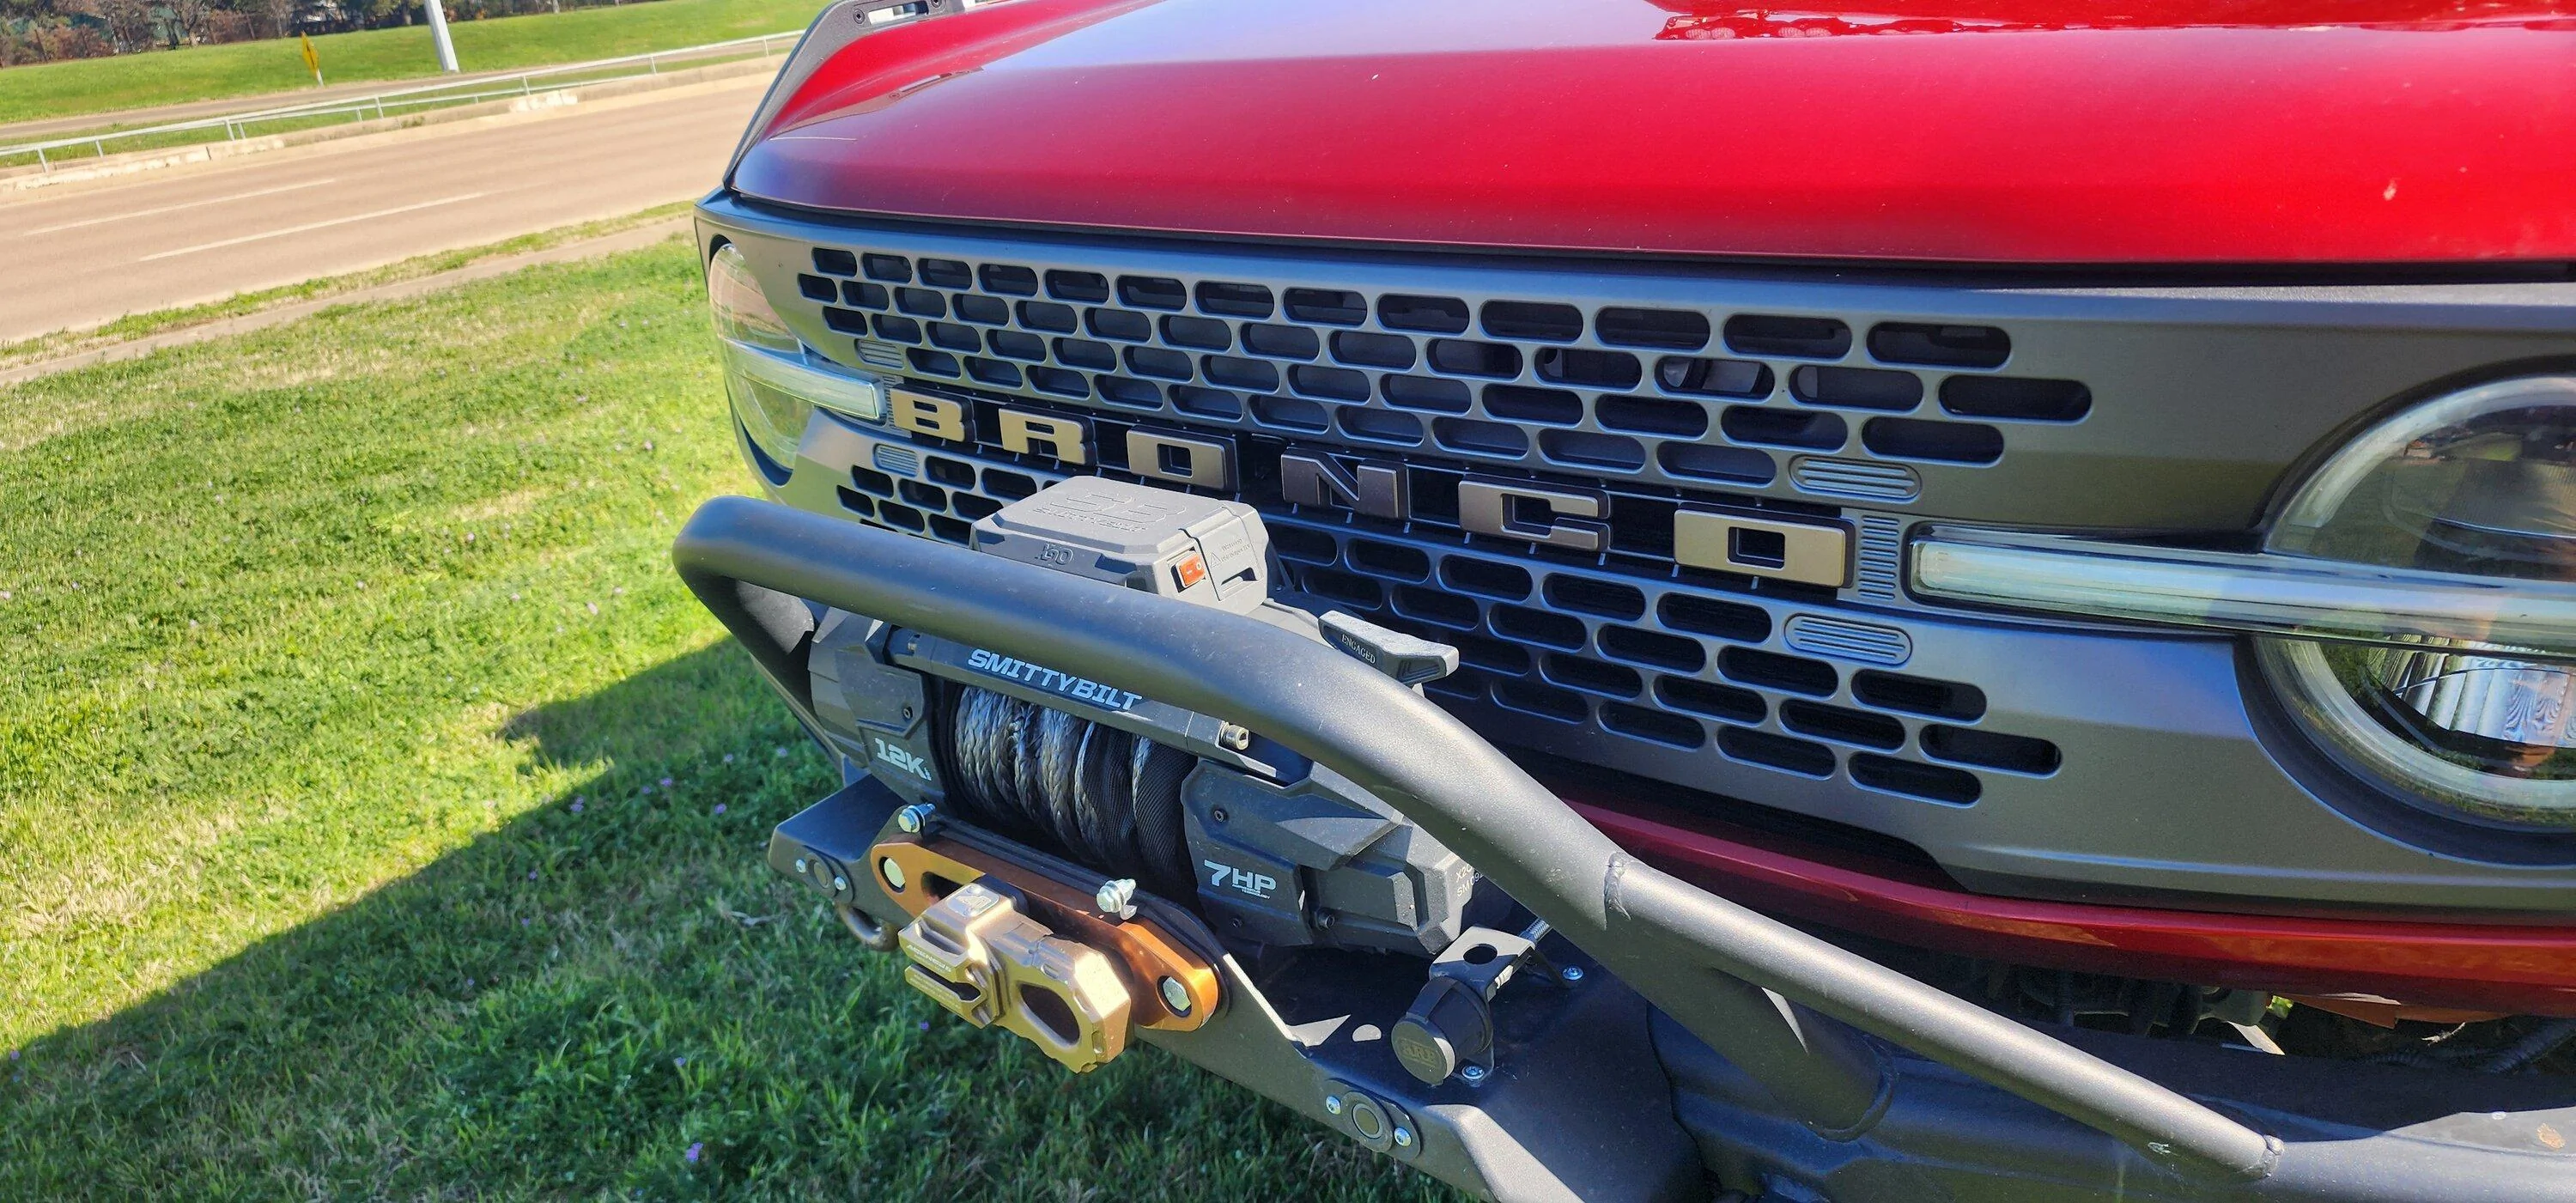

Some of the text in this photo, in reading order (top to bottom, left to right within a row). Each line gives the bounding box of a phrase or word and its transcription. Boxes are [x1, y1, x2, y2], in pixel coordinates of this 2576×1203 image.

[890, 386, 1851, 589] BRONCO
[968, 648, 1143, 710] SMITTYBILT
[1341, 634, 1376, 664] ENGAGED
